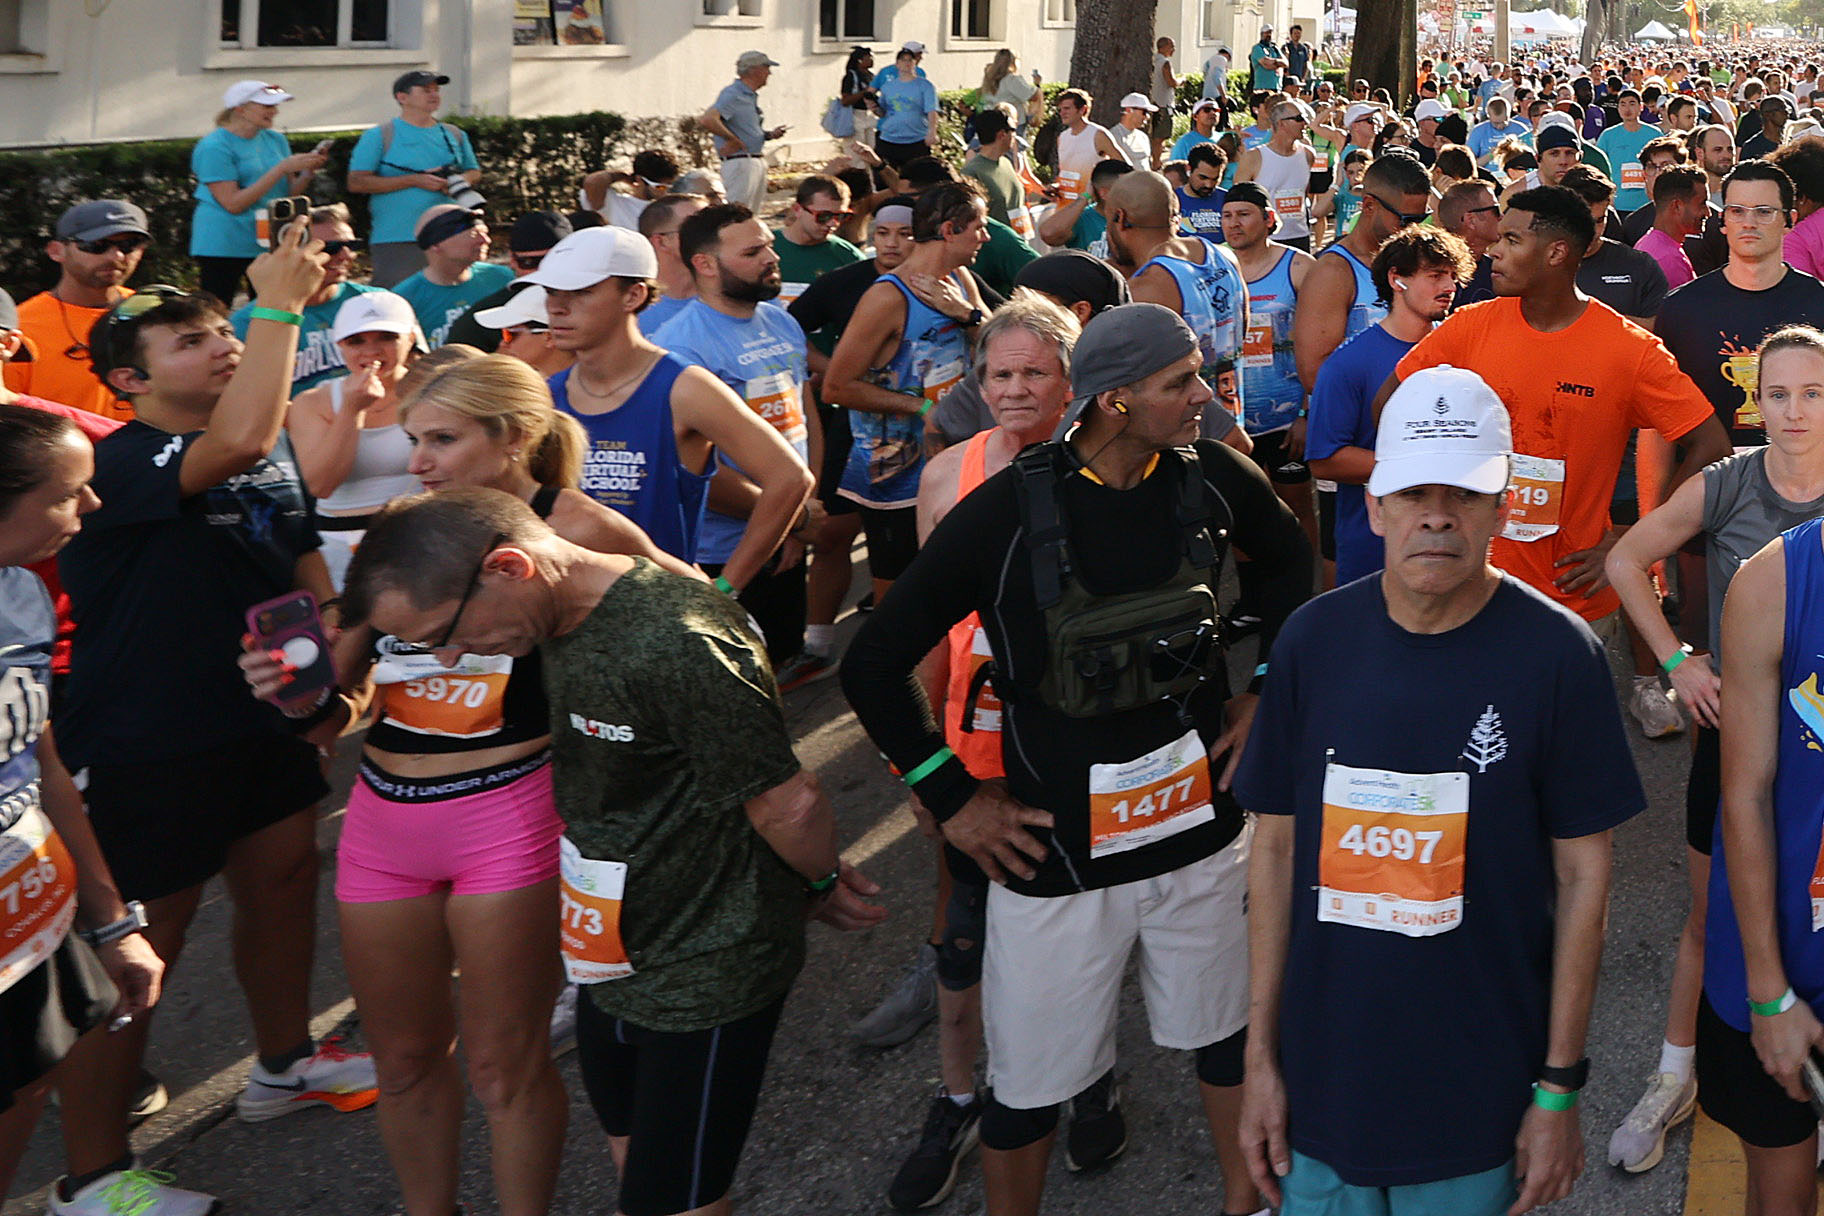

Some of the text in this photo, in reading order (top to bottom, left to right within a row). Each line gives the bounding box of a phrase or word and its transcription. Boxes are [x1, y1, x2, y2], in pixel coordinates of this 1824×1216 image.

[584, 450, 646, 465] LORIDA
[582, 464, 641, 477] IRTUAL
[418, 777, 482, 797] UNDER
[1111, 775, 1195, 824] 1477
[1338, 824, 1444, 864] 4697
[1391, 908, 1460, 928] RUNNER
